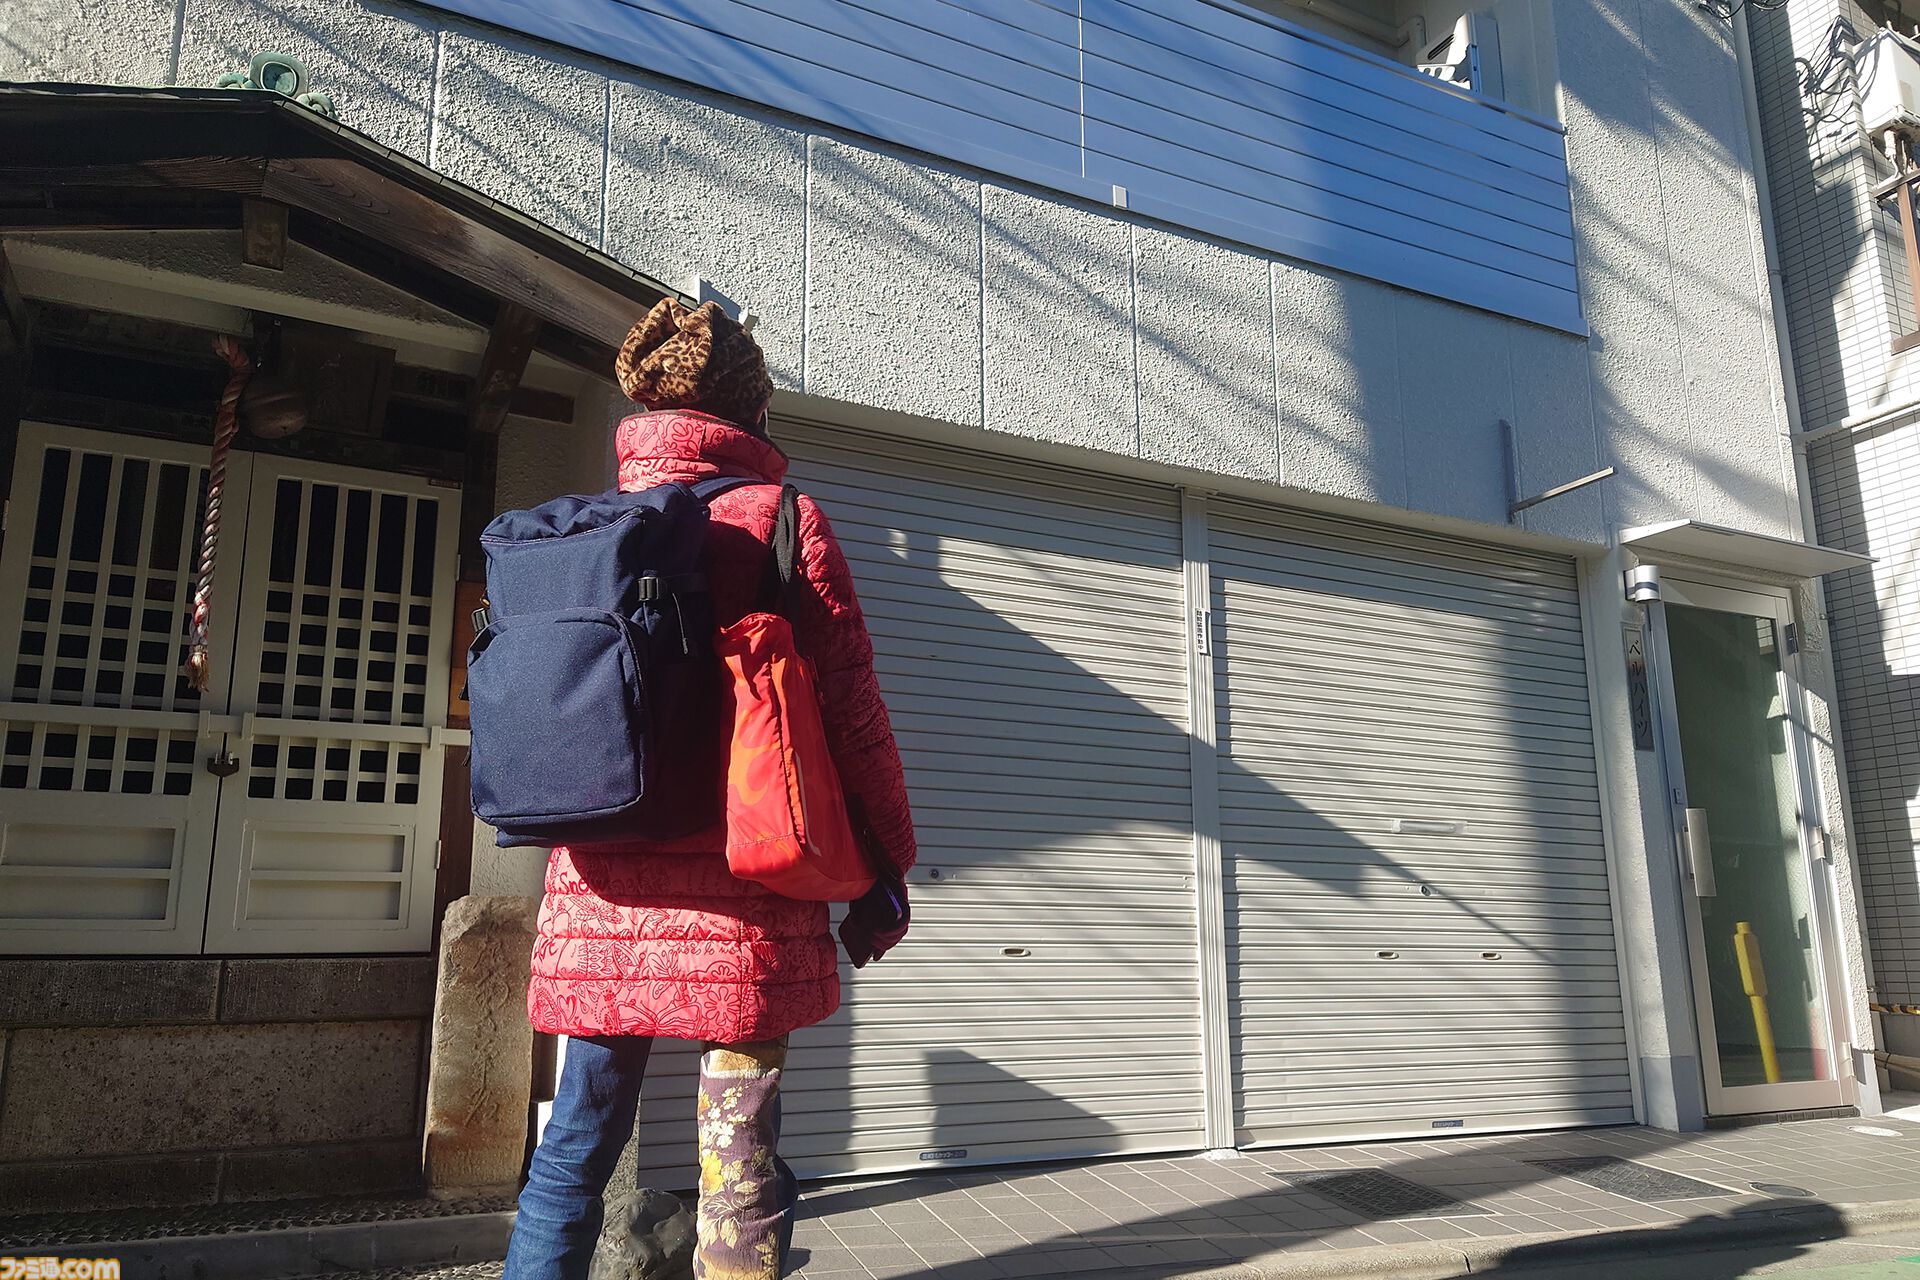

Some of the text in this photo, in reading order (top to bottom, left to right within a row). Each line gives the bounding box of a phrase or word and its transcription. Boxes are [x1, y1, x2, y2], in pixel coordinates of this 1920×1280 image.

[1629, 640, 1648, 737] ベルハイツ
